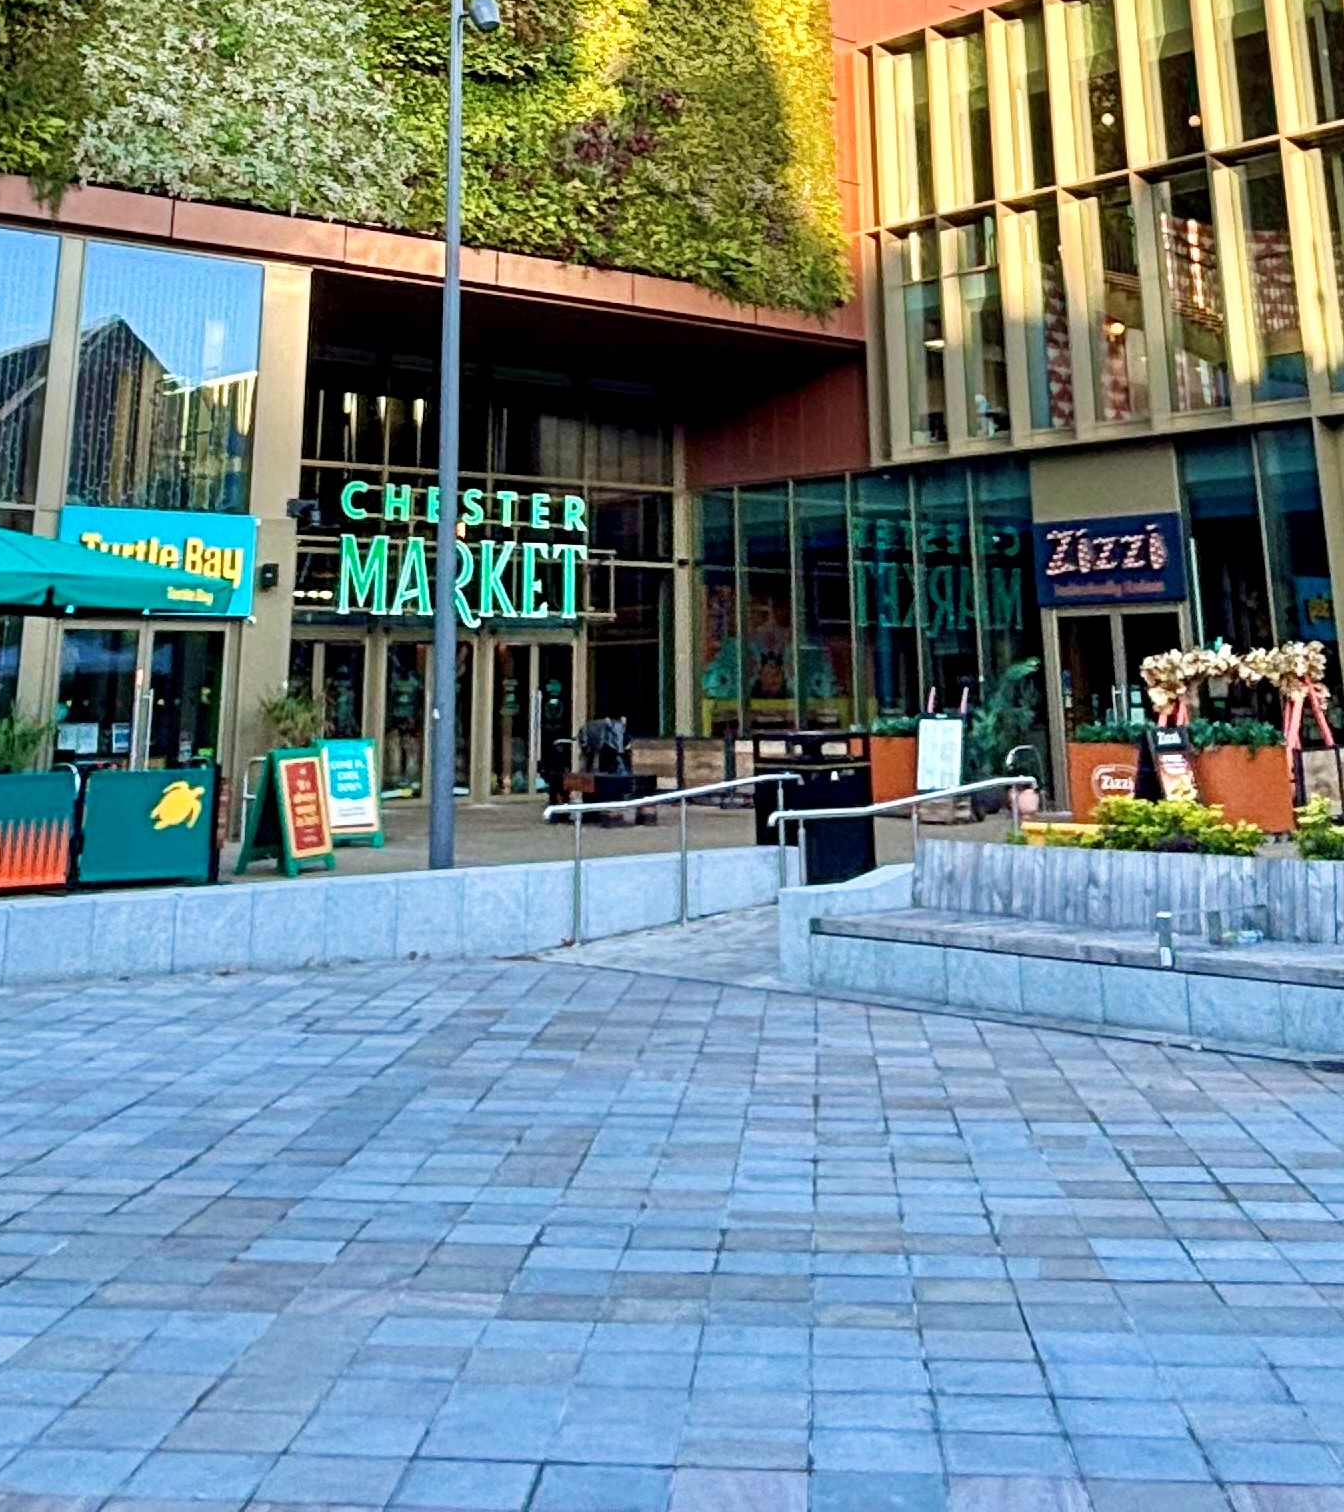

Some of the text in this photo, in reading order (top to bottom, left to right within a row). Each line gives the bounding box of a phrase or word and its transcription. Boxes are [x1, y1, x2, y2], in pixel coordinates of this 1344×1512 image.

[340, 480, 588, 531] CHESTER
[185, 536, 244, 589] Bay
[1045, 523, 1168, 576] Zizzi
[337, 533, 588, 629] MARKET
[1100, 774, 1135, 791] Zizzi
